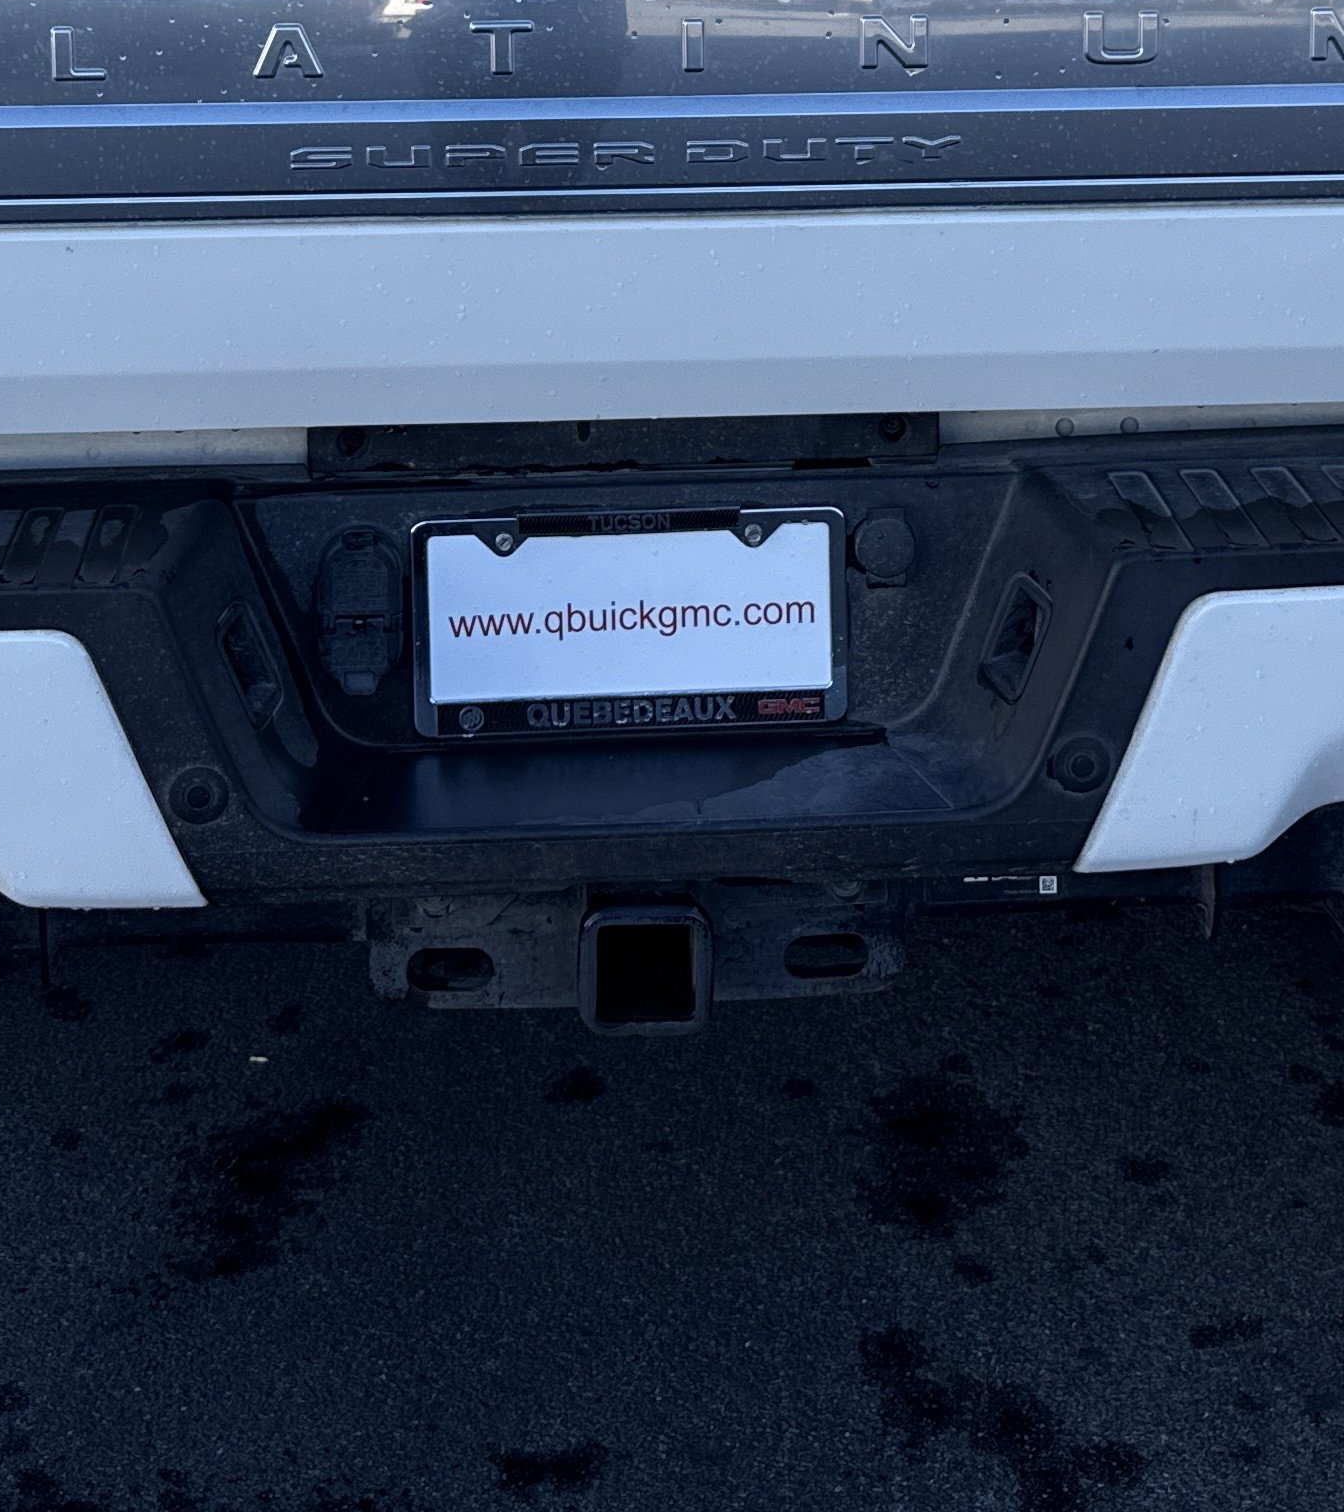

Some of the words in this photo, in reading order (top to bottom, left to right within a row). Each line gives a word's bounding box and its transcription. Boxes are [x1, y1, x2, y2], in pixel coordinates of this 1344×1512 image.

[289, 140, 655, 171] SUPER
[686, 134, 962, 164] DUTY
[588, 513, 672, 533] TUCSON
[449, 600, 816, 640] www.qbuickgmc.com
[526, 695, 737, 728] QUEBEDEAUX
[757, 697, 820, 715] GMC
